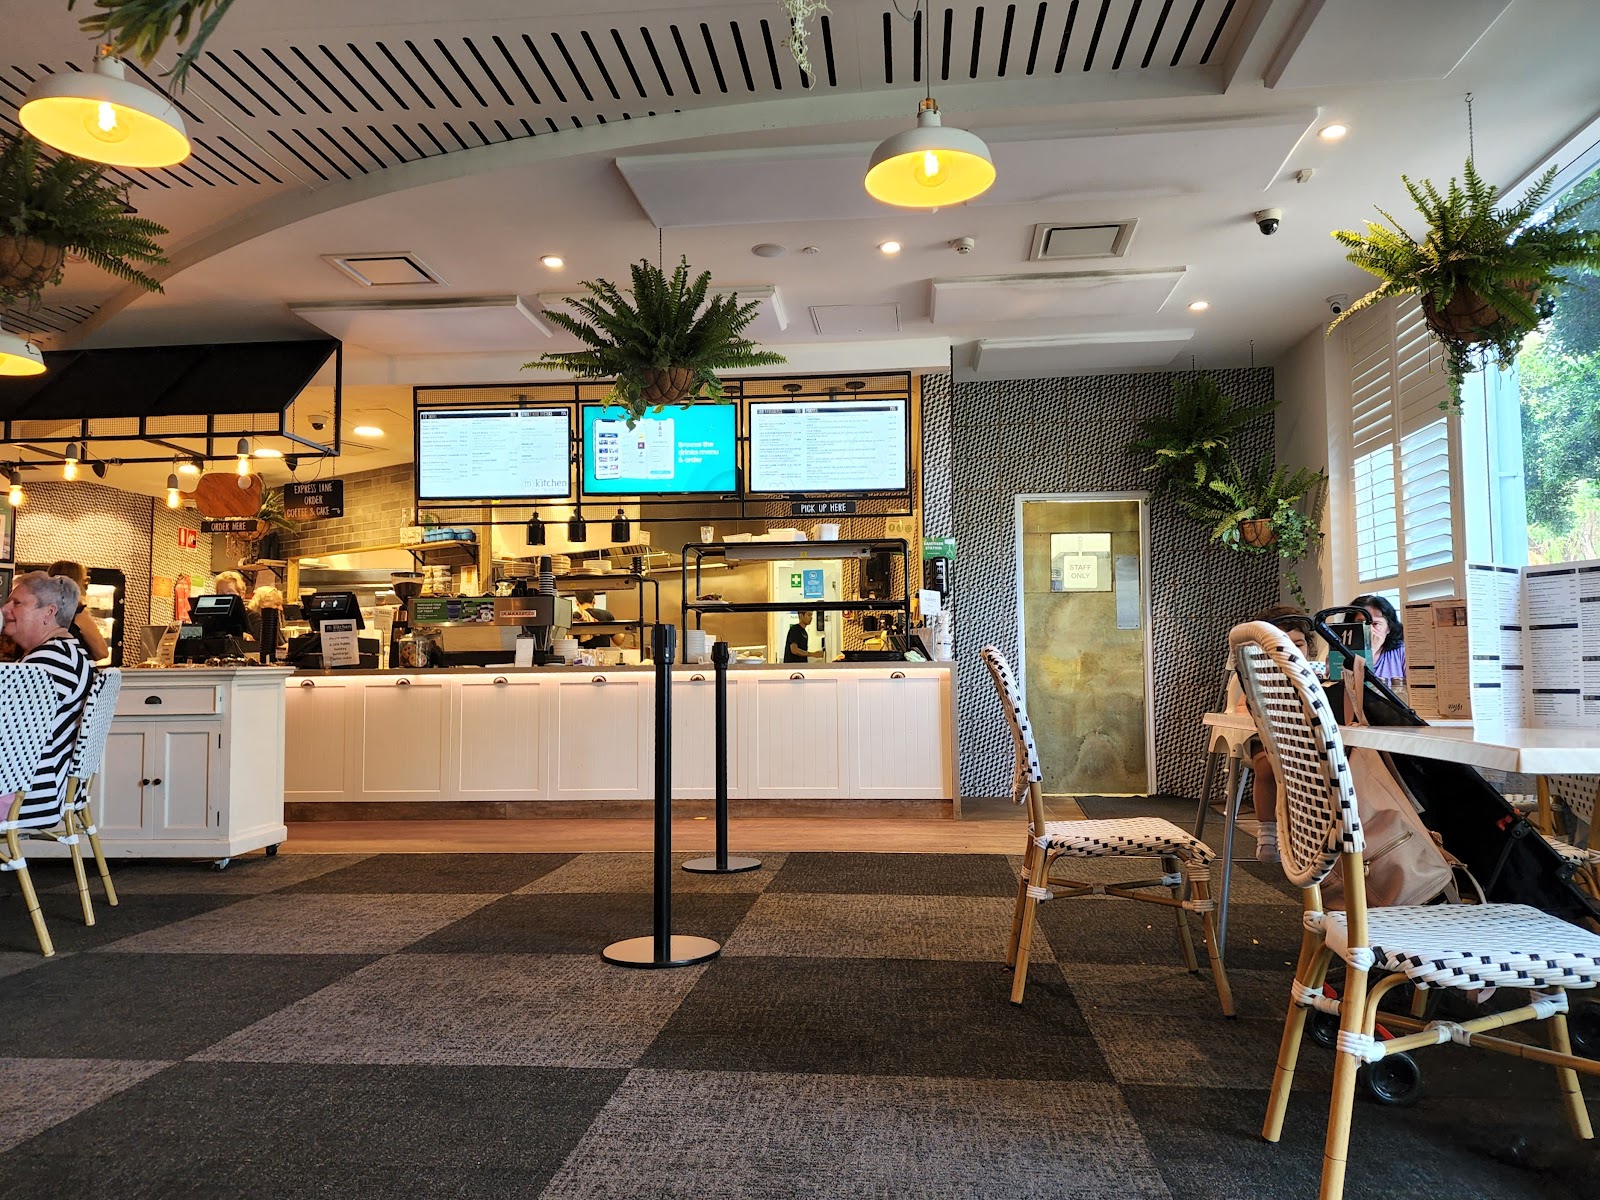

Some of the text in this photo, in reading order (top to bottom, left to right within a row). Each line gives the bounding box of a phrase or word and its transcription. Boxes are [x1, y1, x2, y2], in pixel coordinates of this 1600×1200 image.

[294, 482, 332, 494] EXPRESS LANE
[536, 478, 567, 488] kitchen
[304, 496, 323, 506] ORDER
[286, 506, 330, 518] COFFEE & CAKE
[800, 502, 846, 513] PICK UP HERE
[210, 522, 246, 532] ORDER HERE
[1341, 630, 1353, 645] 11
